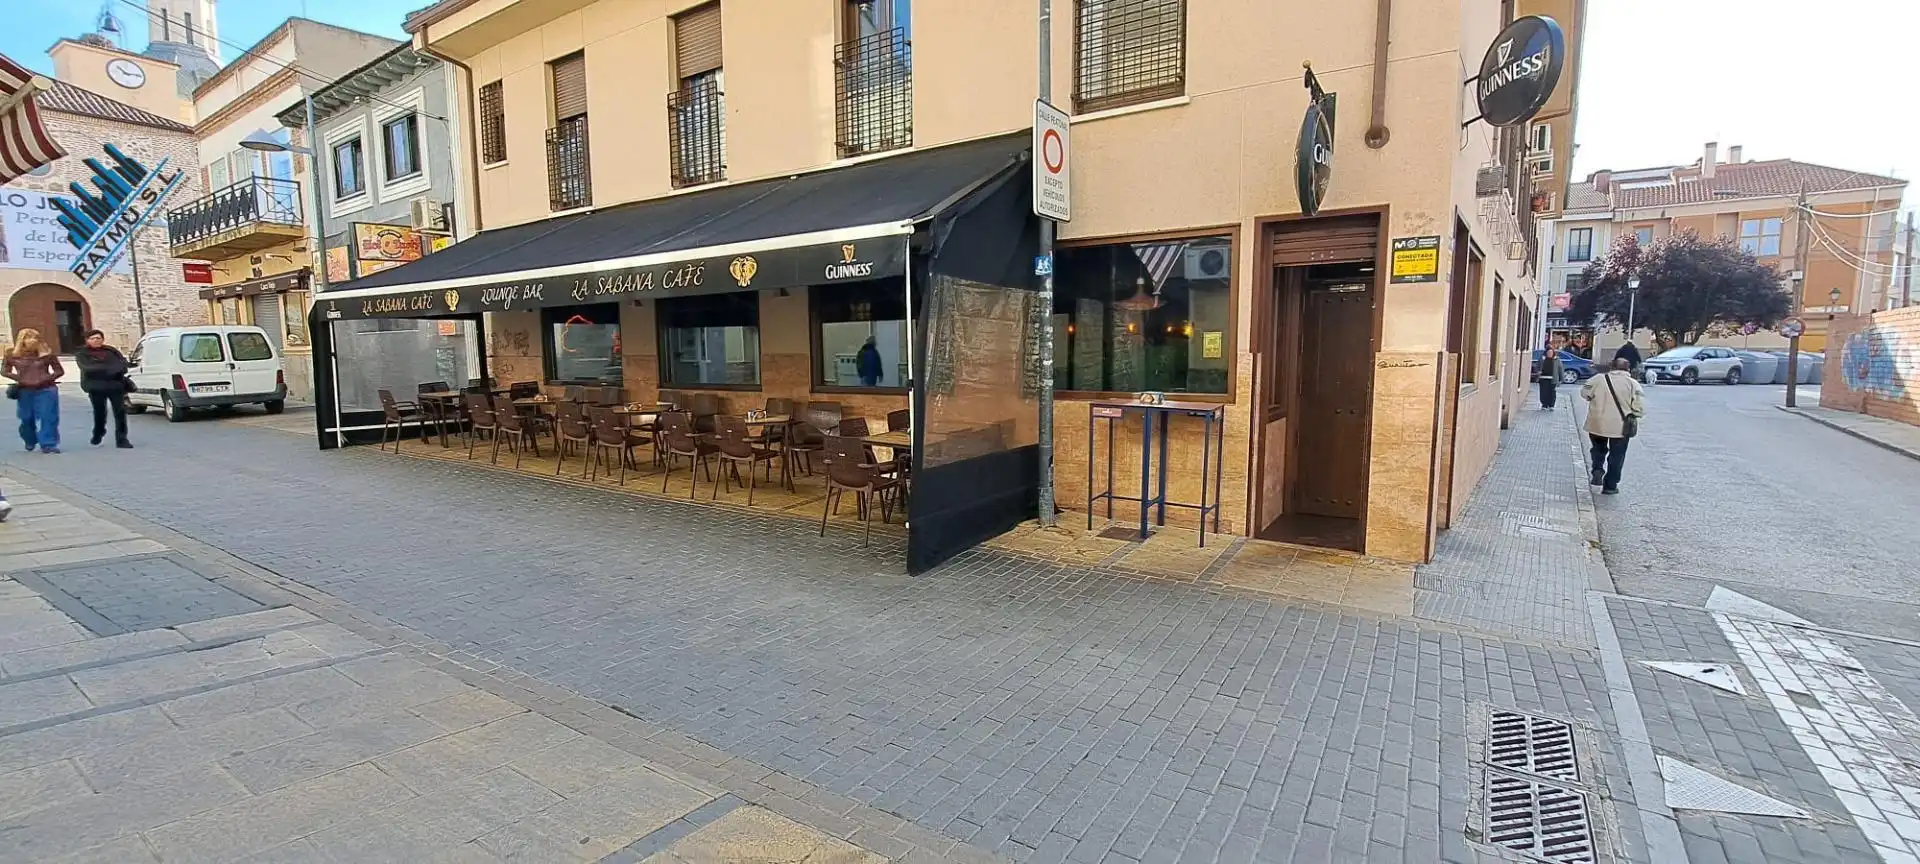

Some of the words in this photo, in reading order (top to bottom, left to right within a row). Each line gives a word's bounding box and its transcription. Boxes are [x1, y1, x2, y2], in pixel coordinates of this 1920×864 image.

[1480, 52, 1543, 101] GUINNESS
[25, 230, 46, 242] de
[571, 280, 590, 301] LA
[595, 272, 656, 296] SABANA
[662, 261, 706, 290] CAFÉ
[825, 261, 874, 280] GUINNESS
[362, 301, 373, 317] LA
[375, 298, 408, 313] SABANA
[481, 287, 518, 310] LOUNGE
[523, 283, 545, 301] BAR
